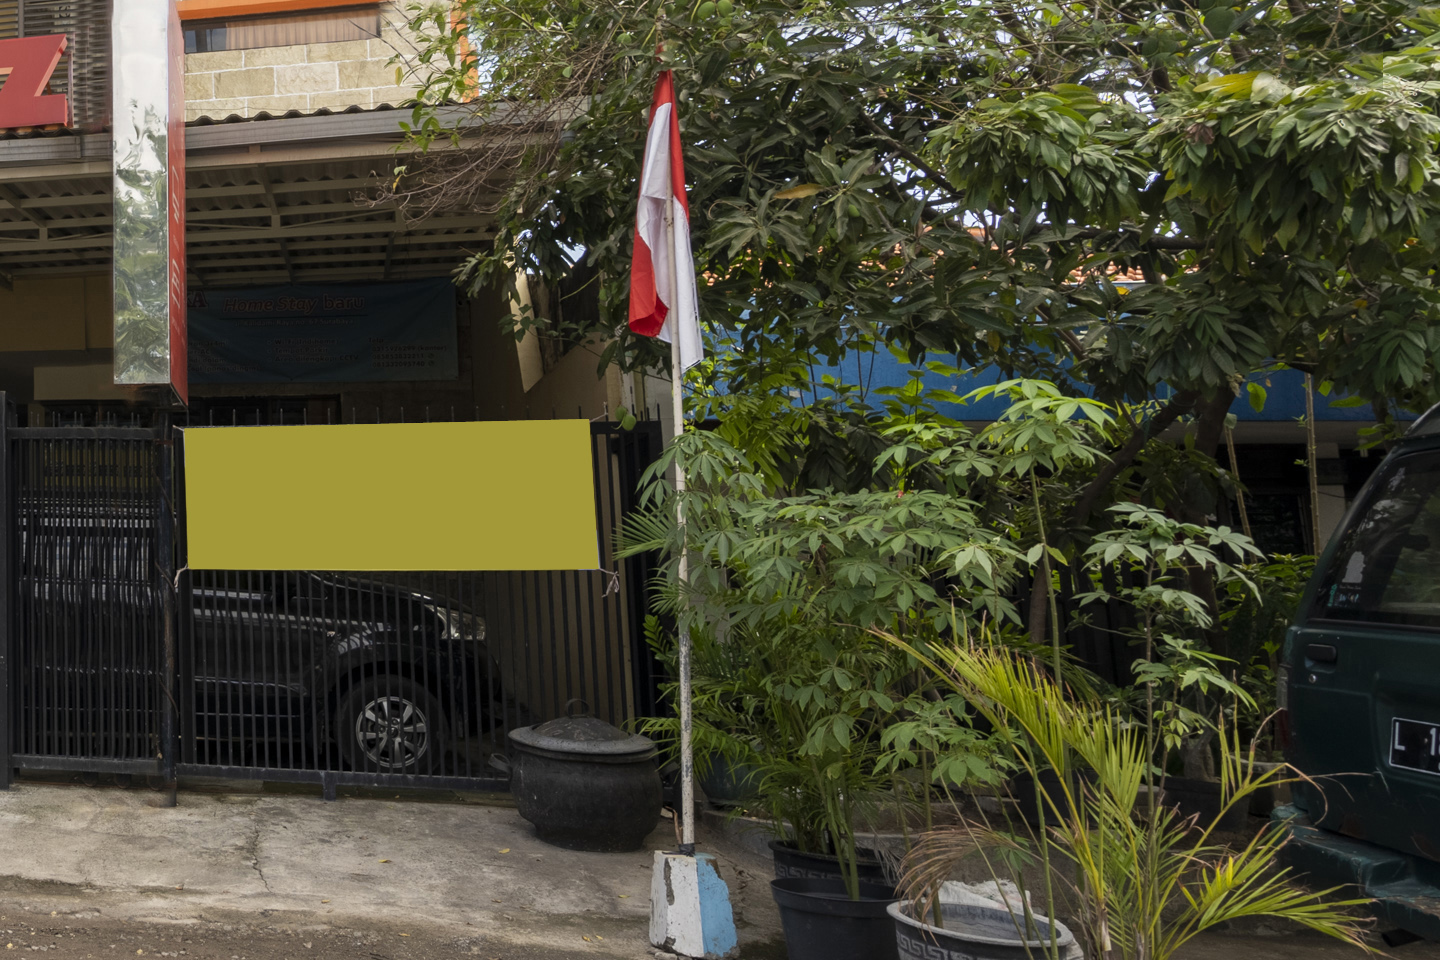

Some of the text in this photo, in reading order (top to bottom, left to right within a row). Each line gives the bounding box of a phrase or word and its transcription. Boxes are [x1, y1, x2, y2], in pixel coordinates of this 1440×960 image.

[223, 293, 365, 315] Home Stay baru
[320, 317, 354, 326] Surabaya
[1394, 721, 1440, 756] L 1
